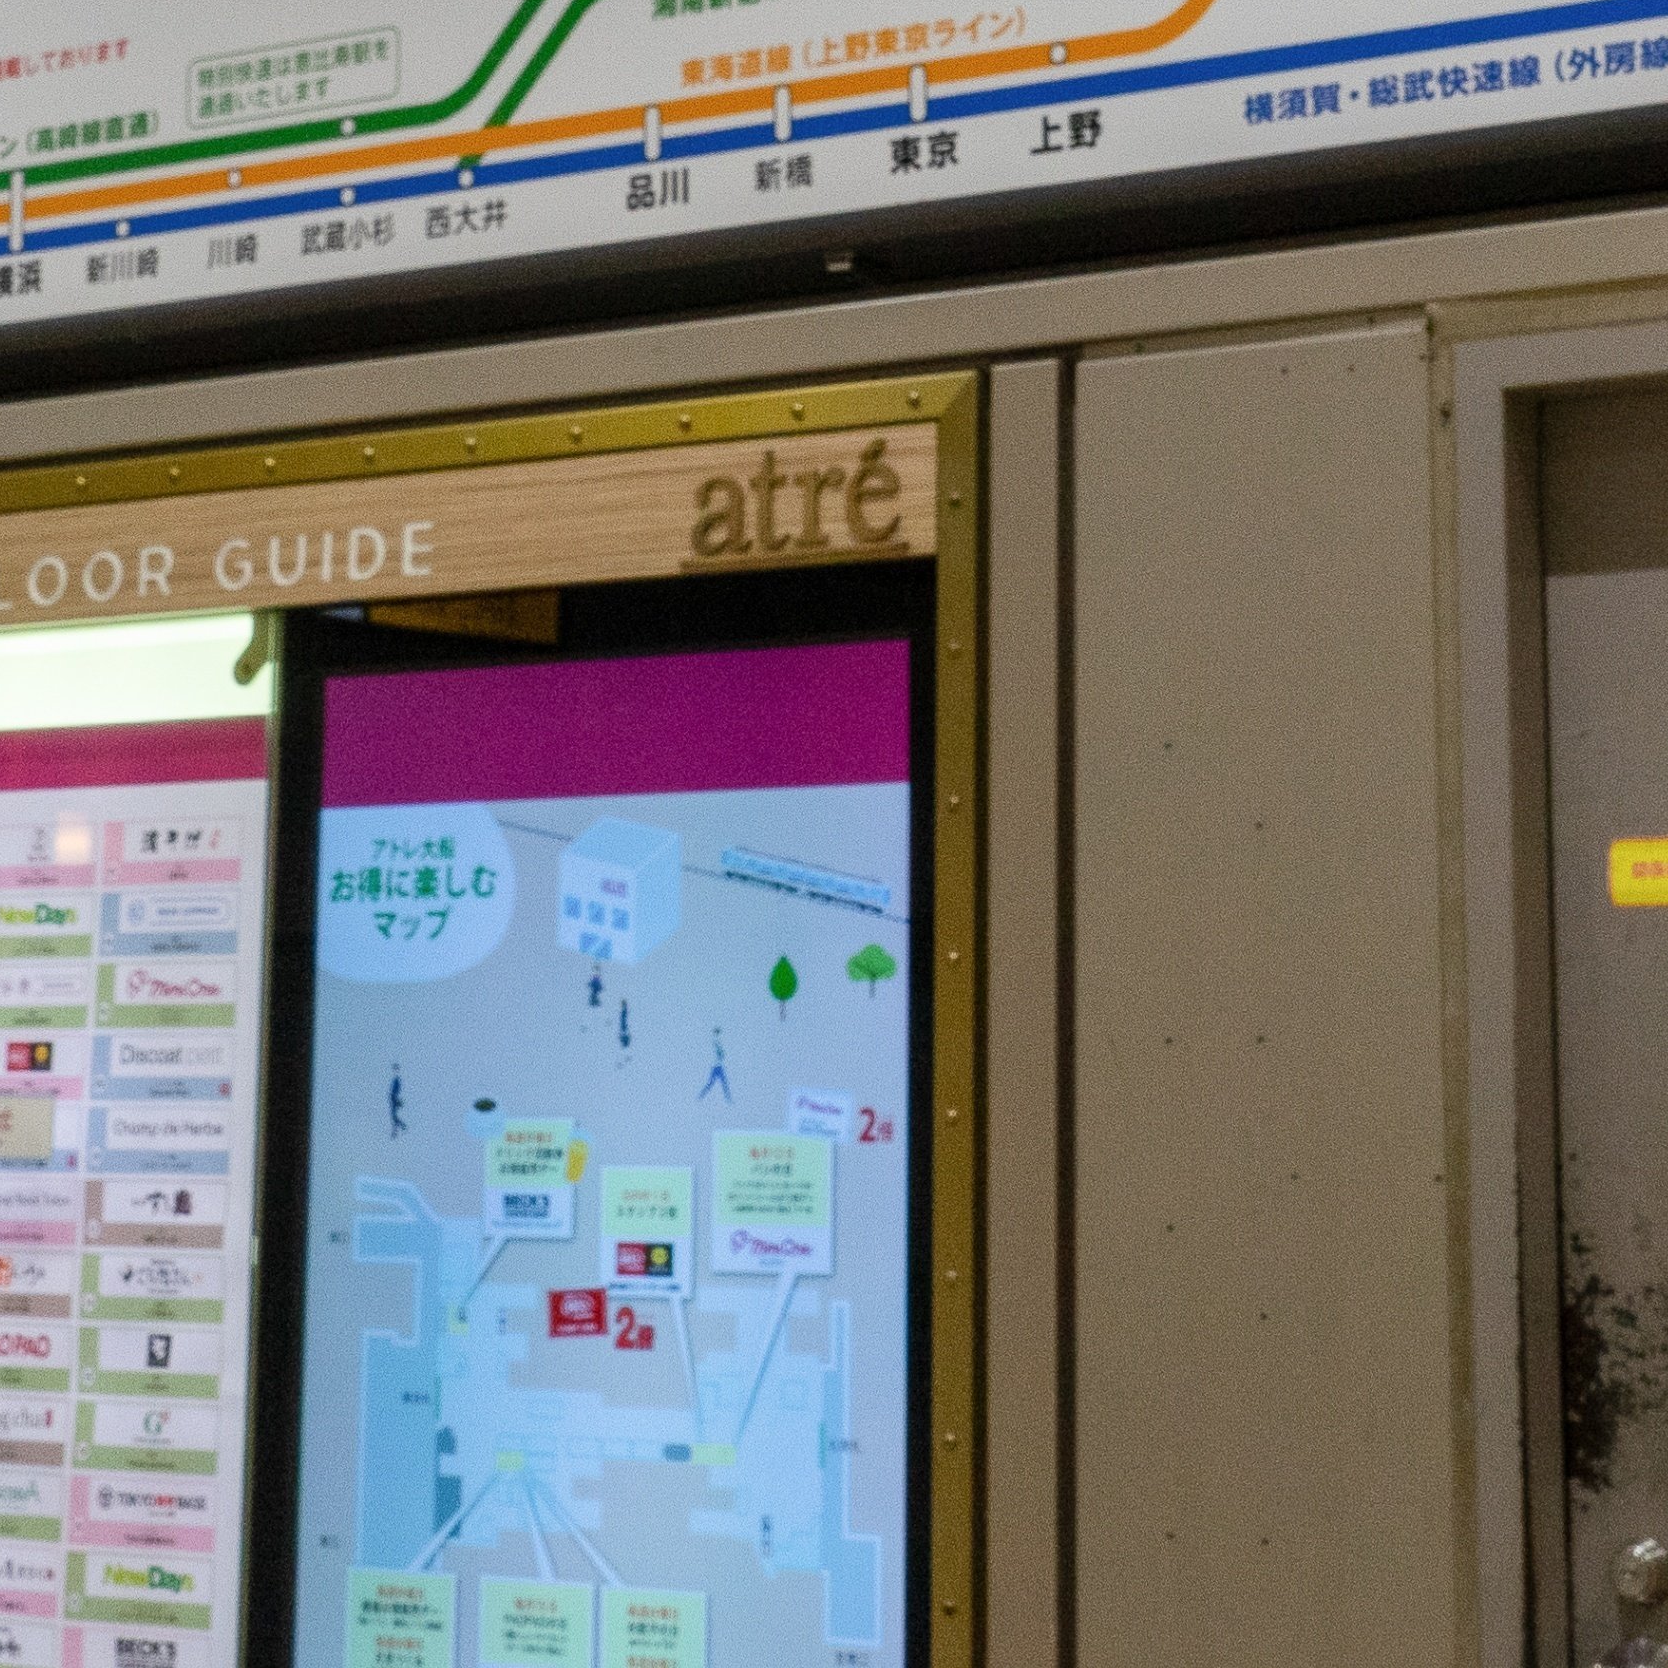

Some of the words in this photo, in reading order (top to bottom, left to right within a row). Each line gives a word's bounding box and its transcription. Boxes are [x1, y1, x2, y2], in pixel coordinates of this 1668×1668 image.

[889, 131, 961, 175] 東京
[1030, 108, 1103, 157] 上野
[626, 167, 691, 212] 品川
[754, 153, 813, 193] 新橋
[300, 213, 396, 255] 武蔵小杉
[424, 199, 509, 239] 西大井
[85, 247, 161, 285] 新川崎
[207, 233, 260, 268] 川崎
[689, 436, 905, 562] atré
[214, 521, 436, 590] GUIDE
[330, 864, 498, 903] お得に楽しむ
[372, 905, 452, 940] マップ
